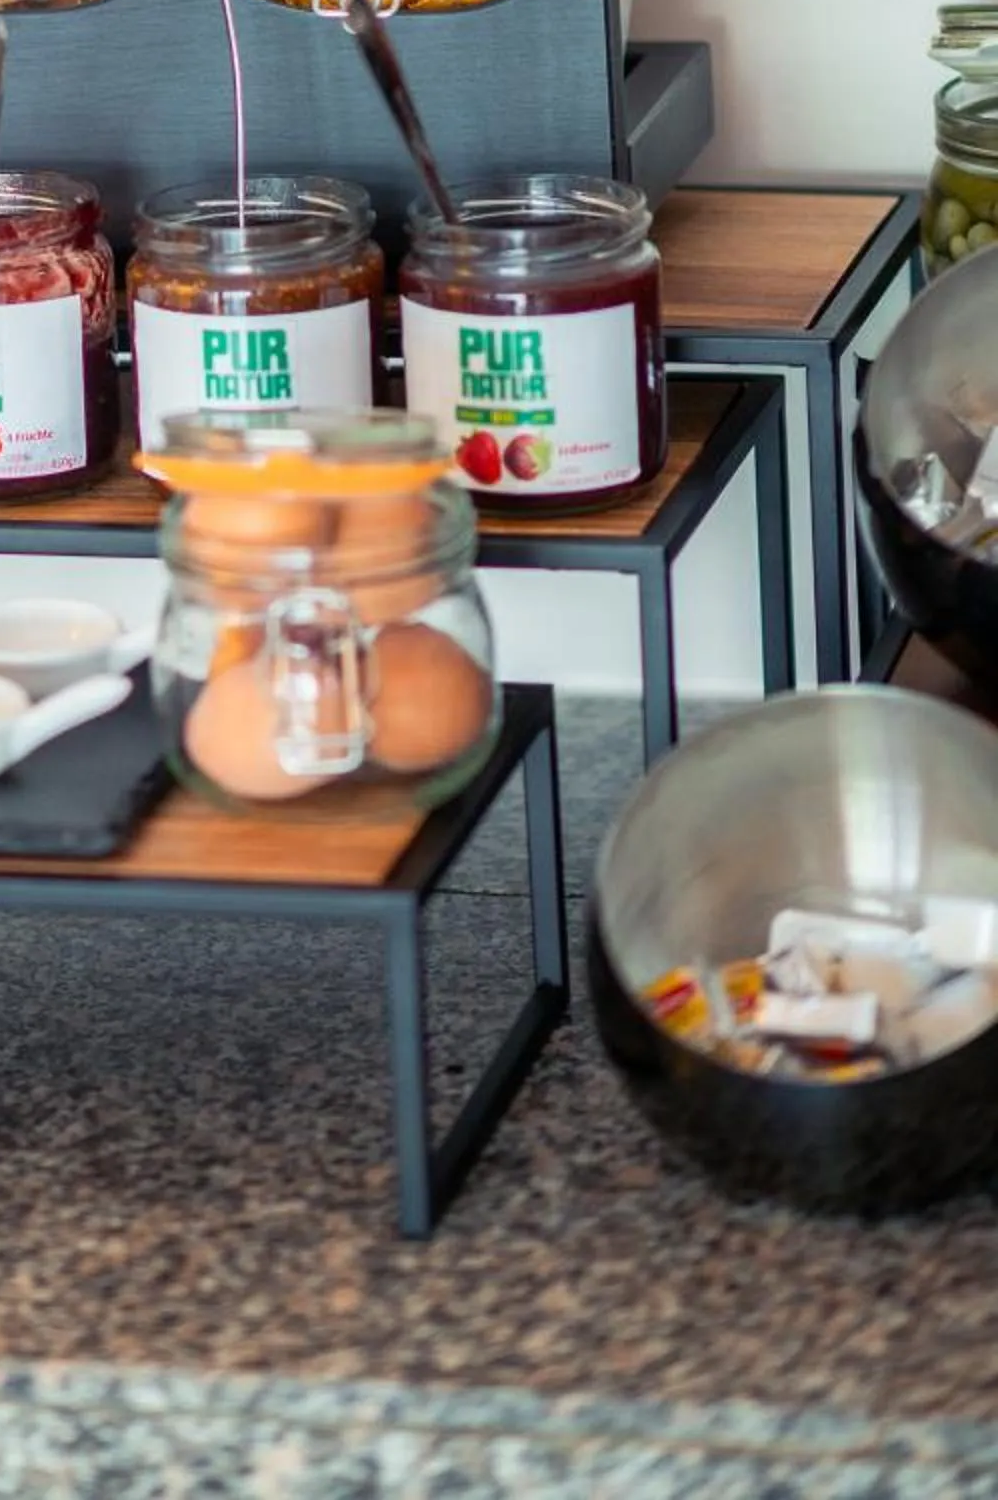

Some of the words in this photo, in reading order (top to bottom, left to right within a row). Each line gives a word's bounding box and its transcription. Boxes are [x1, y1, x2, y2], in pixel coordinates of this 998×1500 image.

[202, 329, 289, 371] PUR
[459, 327, 544, 371] PUR
[205, 372, 292, 400] NATUR
[461, 372, 547, 400] NATUR
